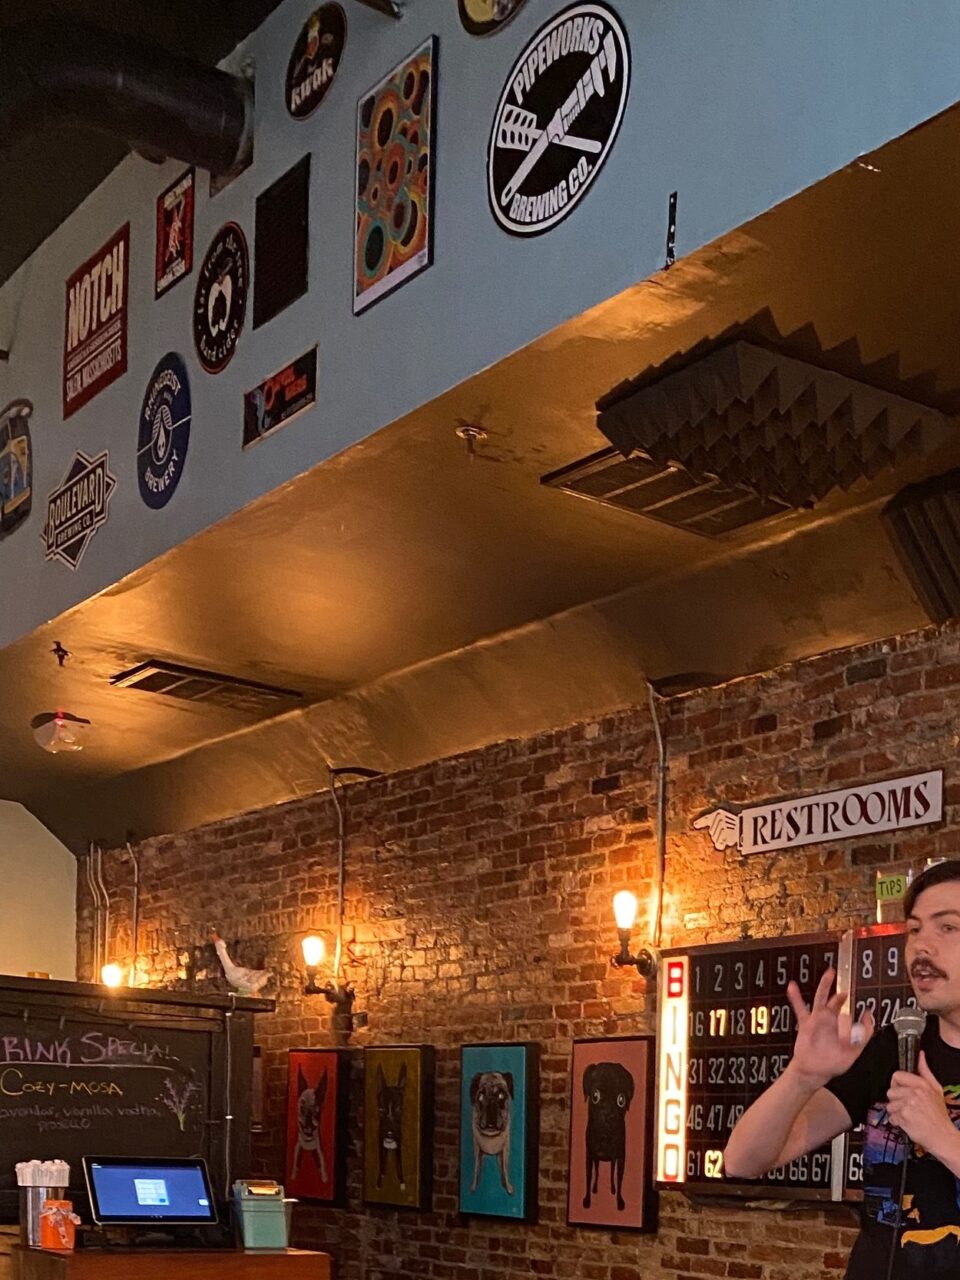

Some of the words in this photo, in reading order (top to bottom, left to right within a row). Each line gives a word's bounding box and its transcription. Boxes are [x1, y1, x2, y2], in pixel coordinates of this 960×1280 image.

[512, 16, 605, 105] PIPEWORKS
[509, 183, 568, 223] BREWING
[568, 156, 593, 195] CO.
[67, 240, 125, 351] NOTCH
[144, 448, 179, 493] BREWERY
[49, 467, 104, 545] BOULEVARD
[57, 520, 83, 545] BREWING
[752, 780, 932, 847] RESTROOMS
[878, 879, 903, 896] TIPS
[714, 964, 723, 991] 2
[734, 962, 744, 990] 3
[755, 959, 765, 988] 4
[776, 956, 788, 985] 5
[800, 954, 809, 983] 6
[862, 949, 873, 979] 8
[887, 946, 898, 977] 9
[689, 1011, 704, 1037] 16
[708, 1008, 727, 1037] 17
[730, 1007, 746, 1036] 18
[749, 1005, 769, 1035] 19
[771, 1004, 790, 1034] 20
[688, 1058, 704, 1084] 31
[708, 1057, 725, 1084] 32
[728, 1056, 746, 1084] 33
[749, 1055, 767, 1084] 34
[686, 1104, 704, 1131] 46
[706, 1104, 724, 1132] 47
[686, 1150, 701, 1177] 61
[703, 1149, 724, 1179] 62
[811, 1153, 831, 1183] 67
